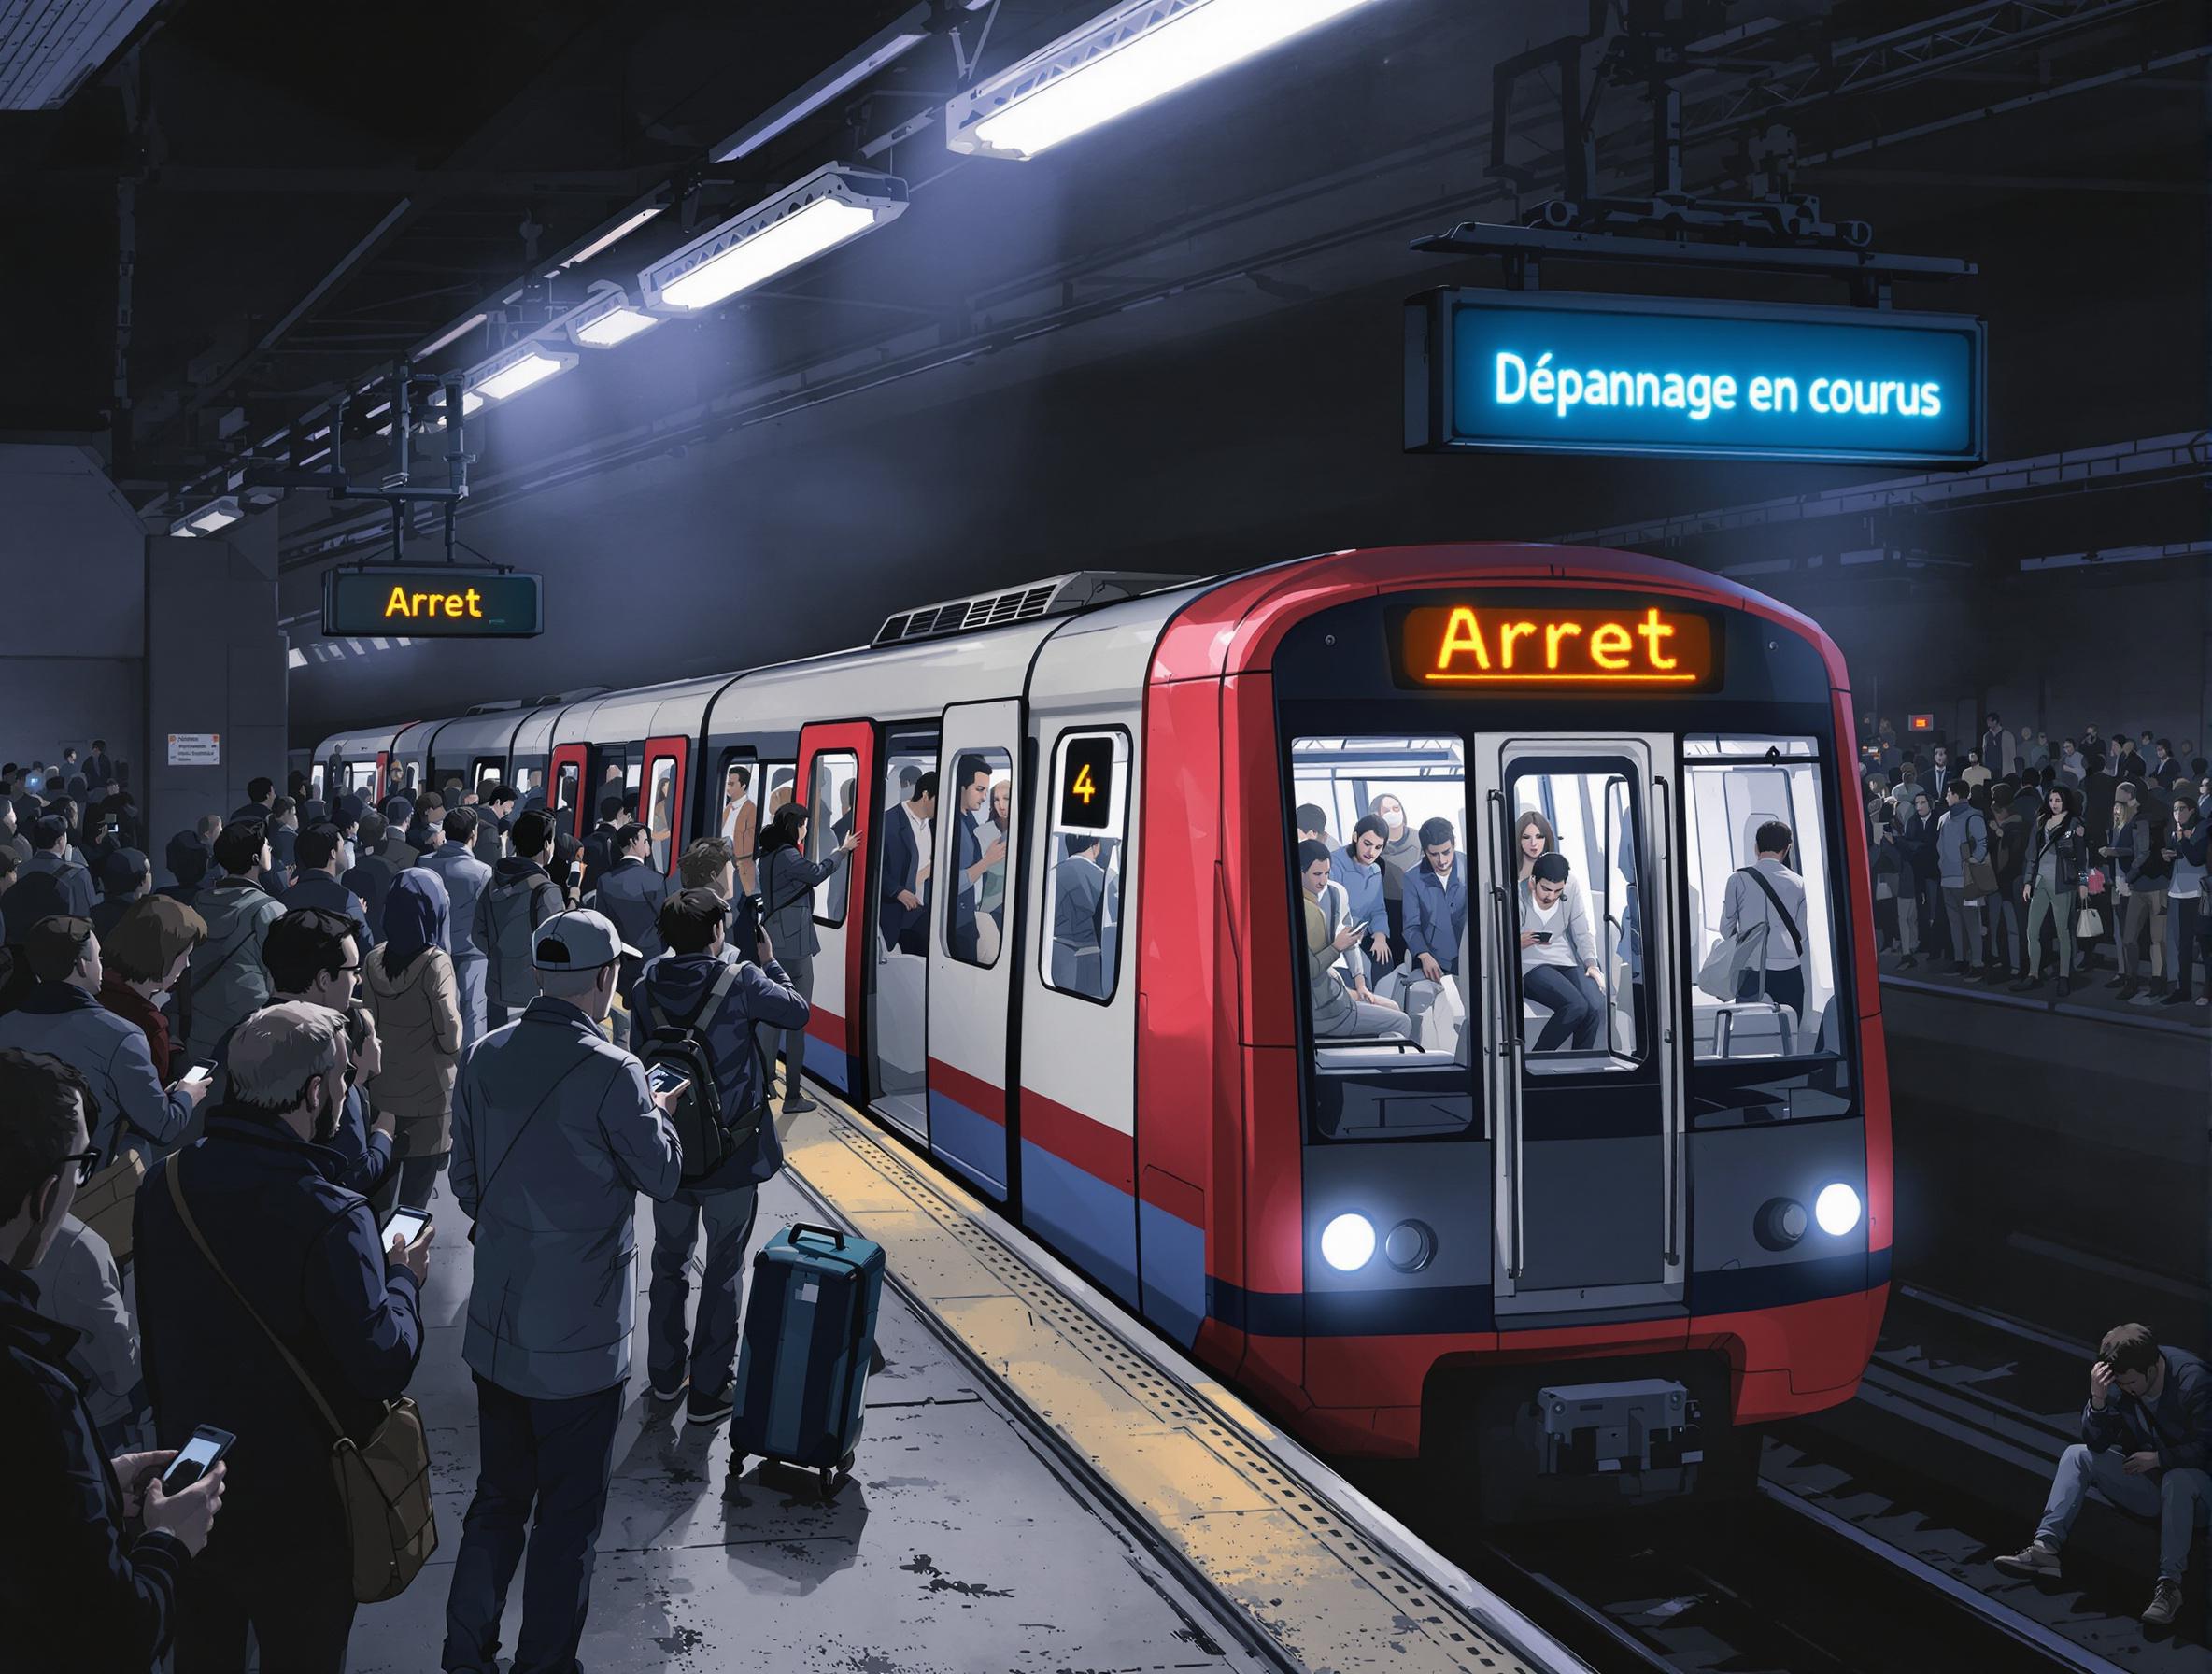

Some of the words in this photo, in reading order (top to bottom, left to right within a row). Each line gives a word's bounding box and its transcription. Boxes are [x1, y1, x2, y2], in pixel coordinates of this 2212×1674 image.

[1495, 351, 1737, 420] Dépannage
[1748, 376, 1798, 413] en
[1808, 377, 1942, 417] courus
[385, 586, 483, 617] Arret
[1436, 606, 1677, 670] Arret
[1072, 763, 1096, 804] 4
